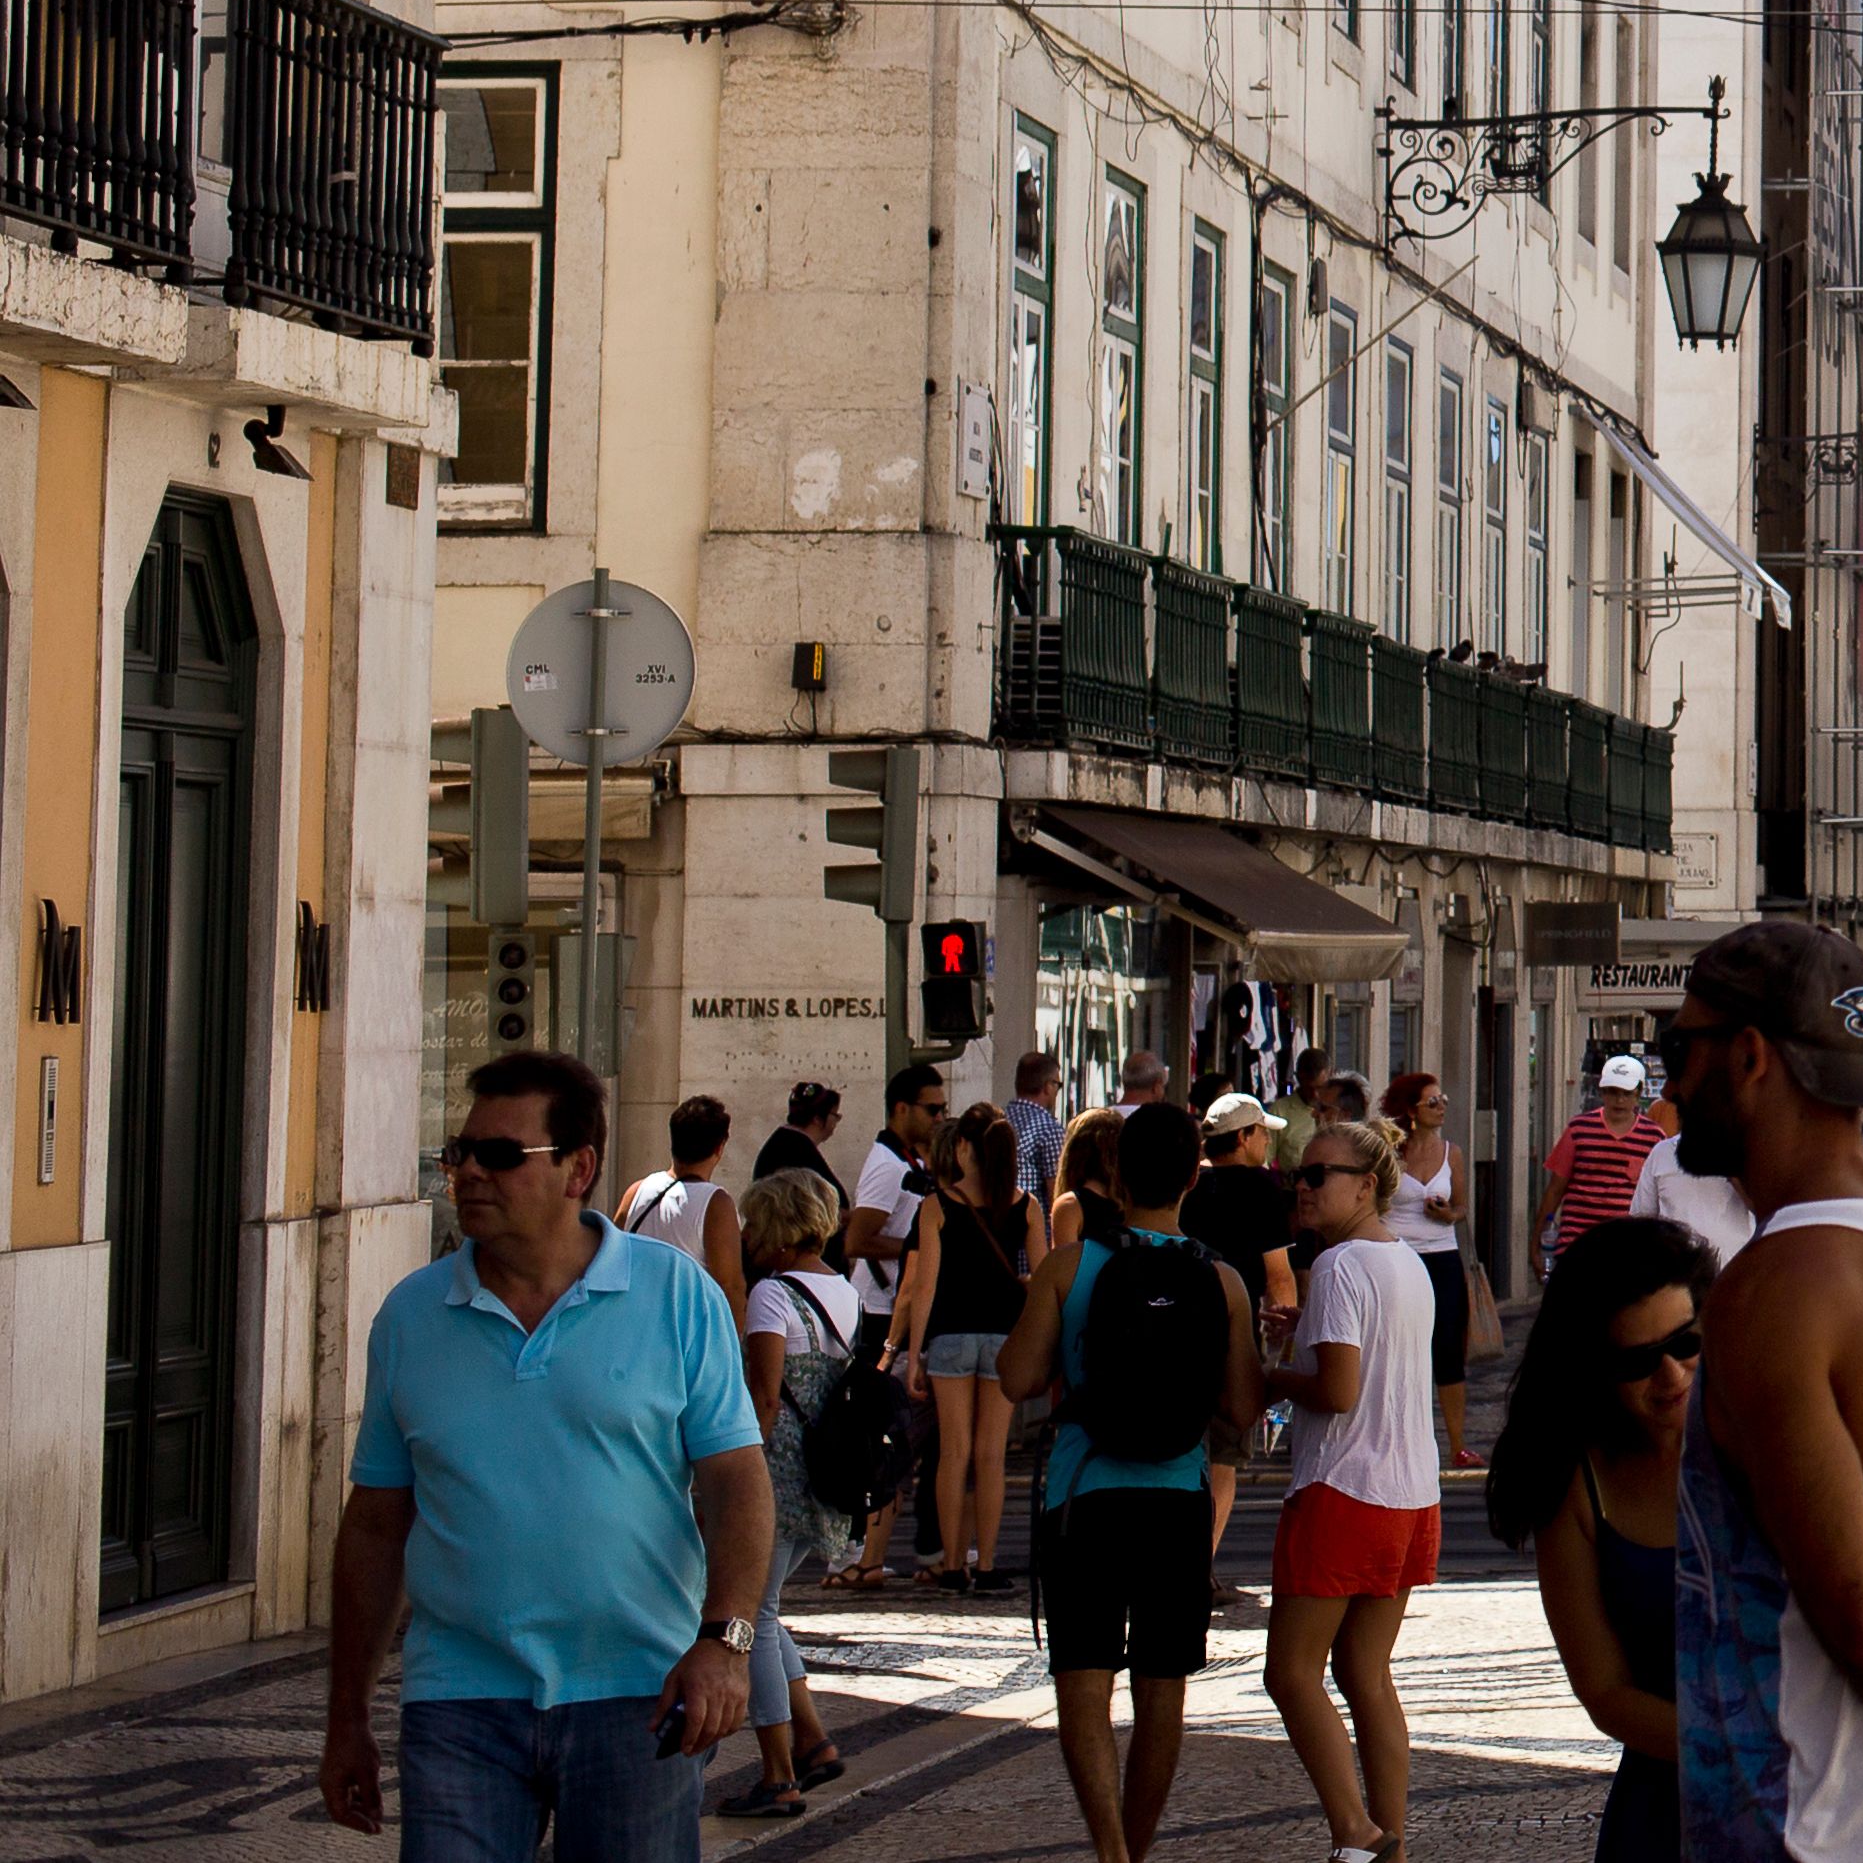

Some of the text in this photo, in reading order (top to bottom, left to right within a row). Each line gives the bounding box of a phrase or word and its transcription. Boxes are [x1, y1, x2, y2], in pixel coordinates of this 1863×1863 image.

[525, 665, 550, 674] CML
[647, 665, 666, 674] XVI
[692, 998, 780, 1018] MARTINS
[785, 998, 801, 1018] &
